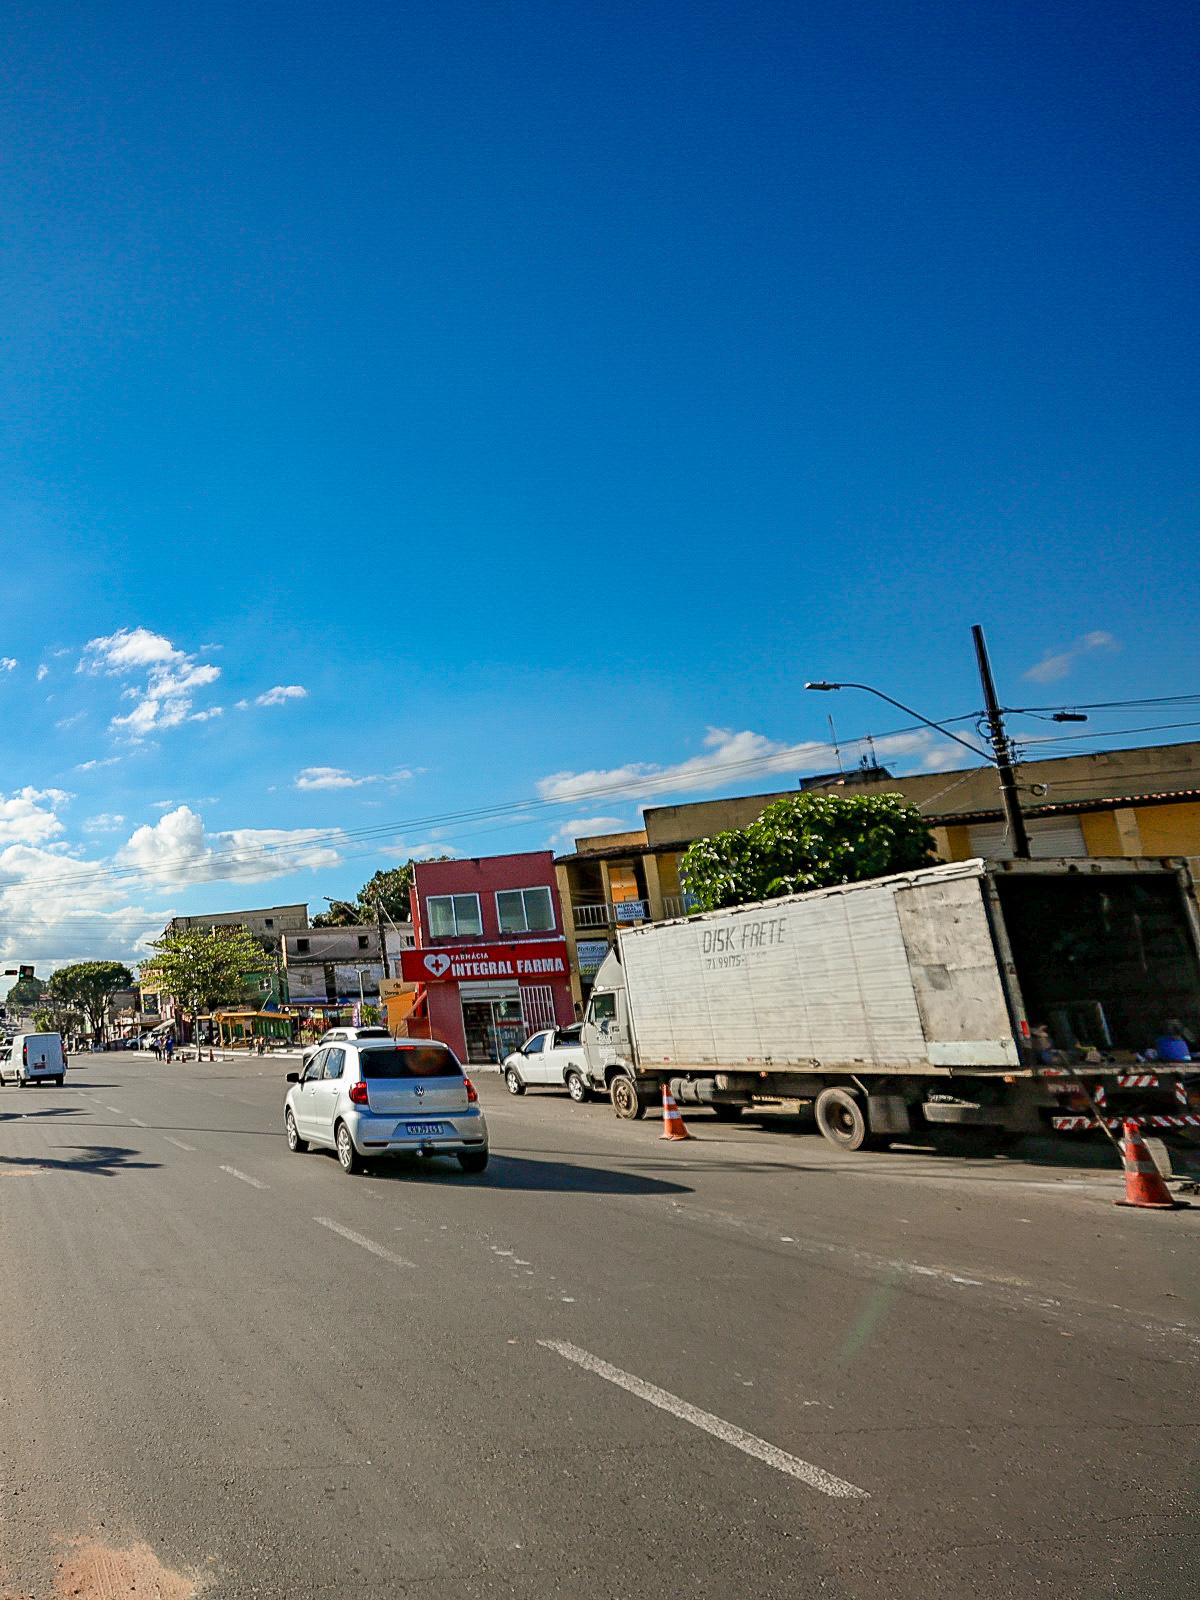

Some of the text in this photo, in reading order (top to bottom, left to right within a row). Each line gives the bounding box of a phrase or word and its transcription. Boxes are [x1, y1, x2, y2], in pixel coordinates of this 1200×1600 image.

[703, 918, 787, 954] DISK FRETE
[450, 952, 489, 960] FARMÁCIA
[451, 960, 514, 977] INTEGRAL
[517, 957, 565, 973] FARMA
